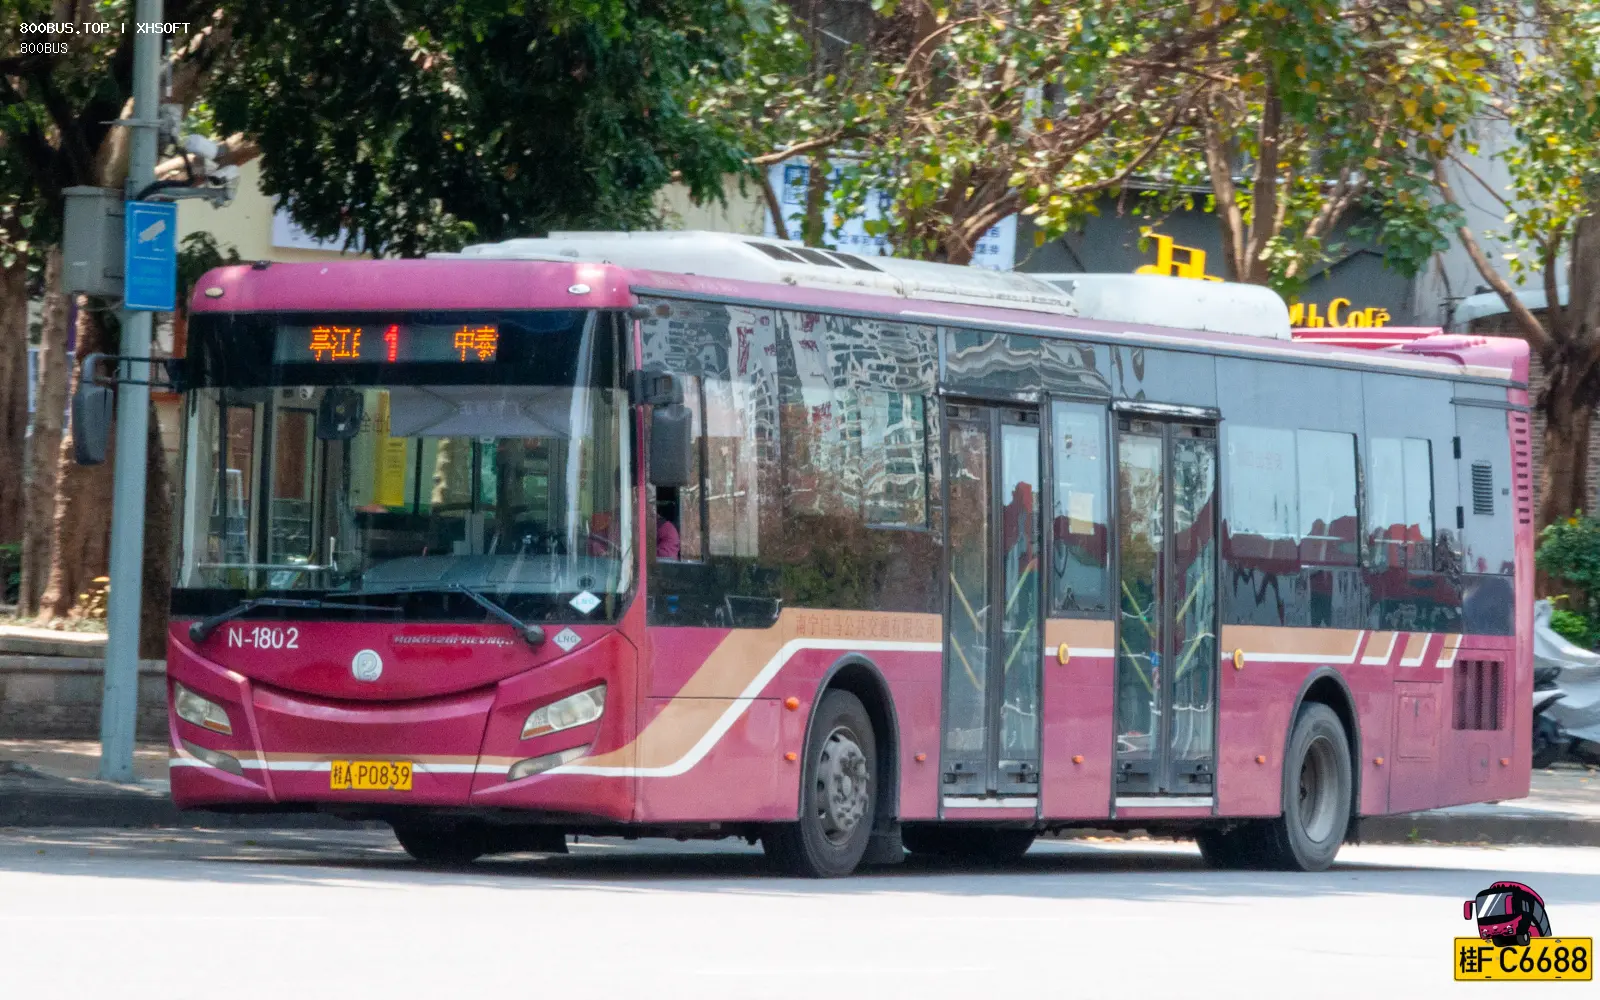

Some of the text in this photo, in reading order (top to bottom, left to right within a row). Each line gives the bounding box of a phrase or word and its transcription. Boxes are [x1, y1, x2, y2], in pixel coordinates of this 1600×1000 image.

[384, 325, 399, 362] 1
[228, 627, 299, 649] N-1802
[796, 613, 936, 639] 南宁白马公共交通有限公司
[557, 634, 577, 645] LNG
